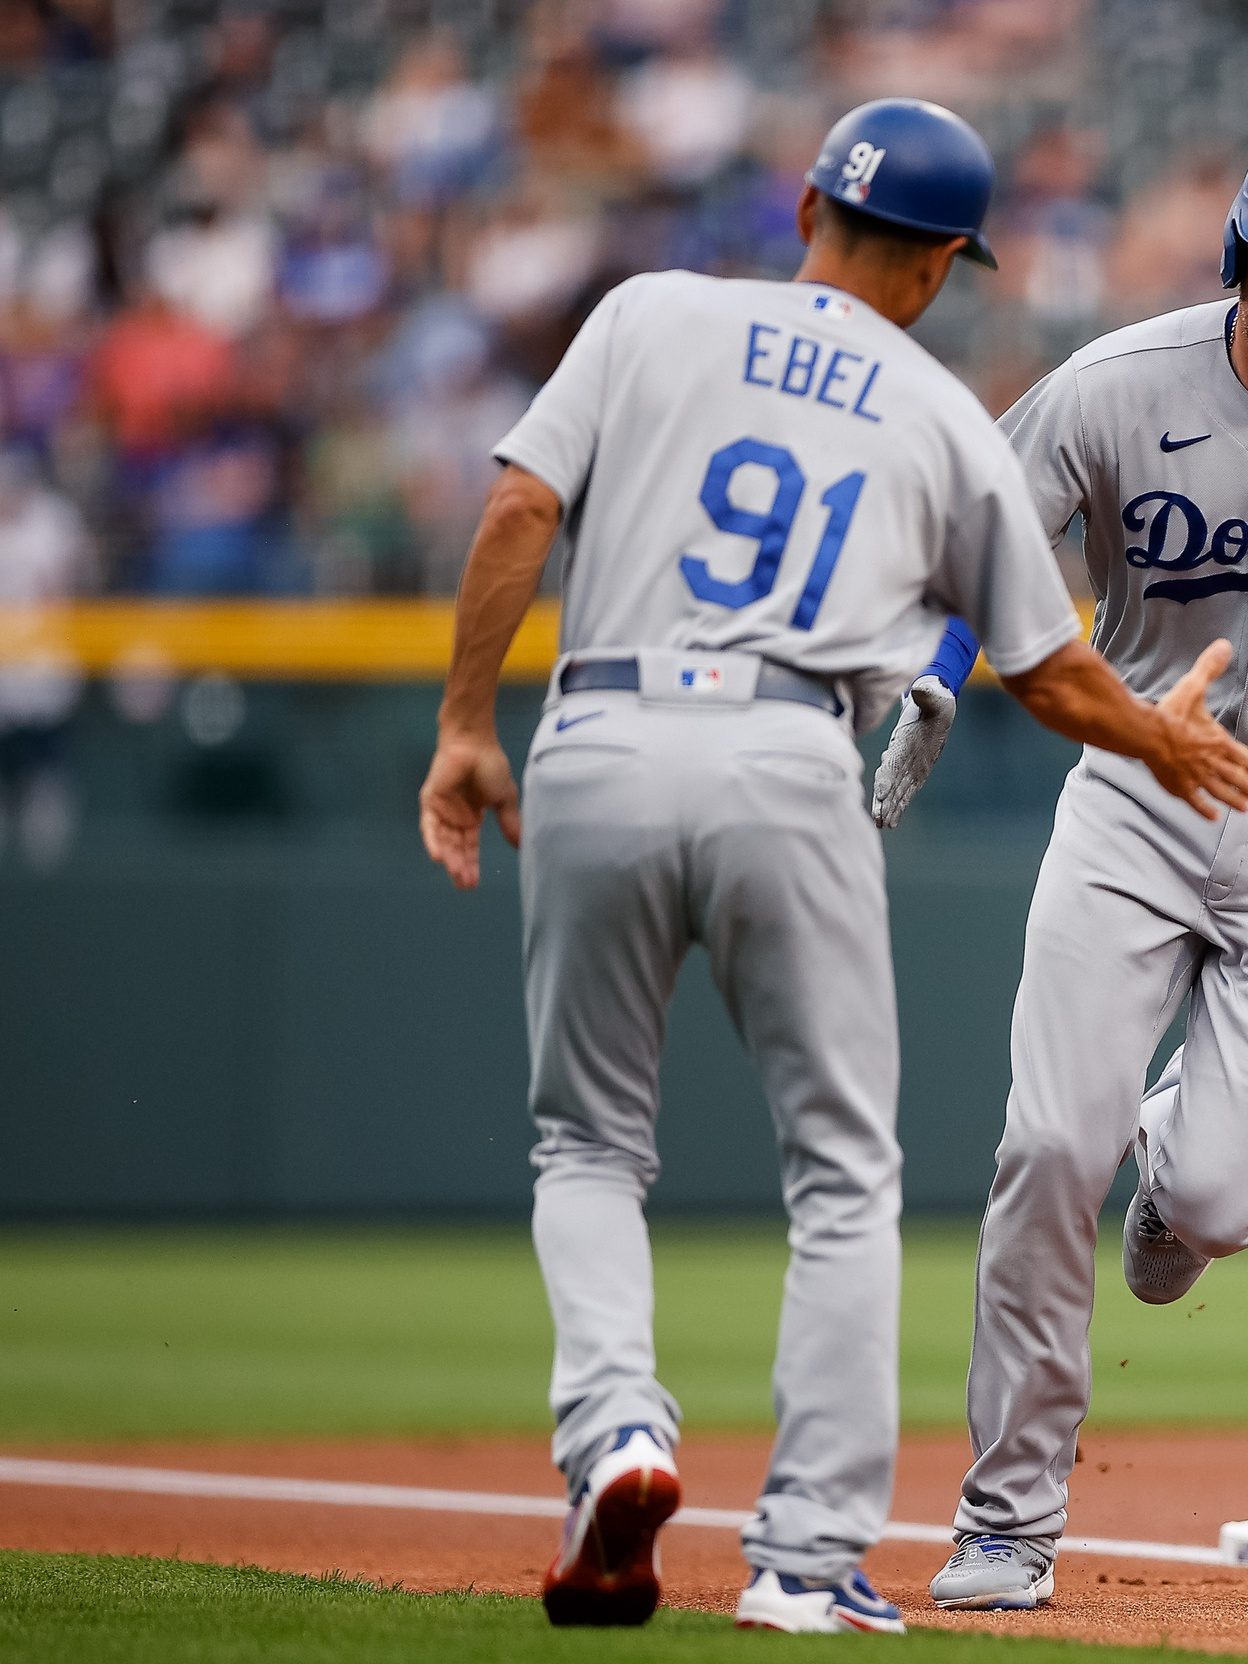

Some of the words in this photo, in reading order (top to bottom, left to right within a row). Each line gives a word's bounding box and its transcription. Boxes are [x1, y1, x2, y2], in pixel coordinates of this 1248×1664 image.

[842, 141, 887, 184] 91
[744, 321, 881, 424] EBEL
[679, 436, 866, 632] 91
